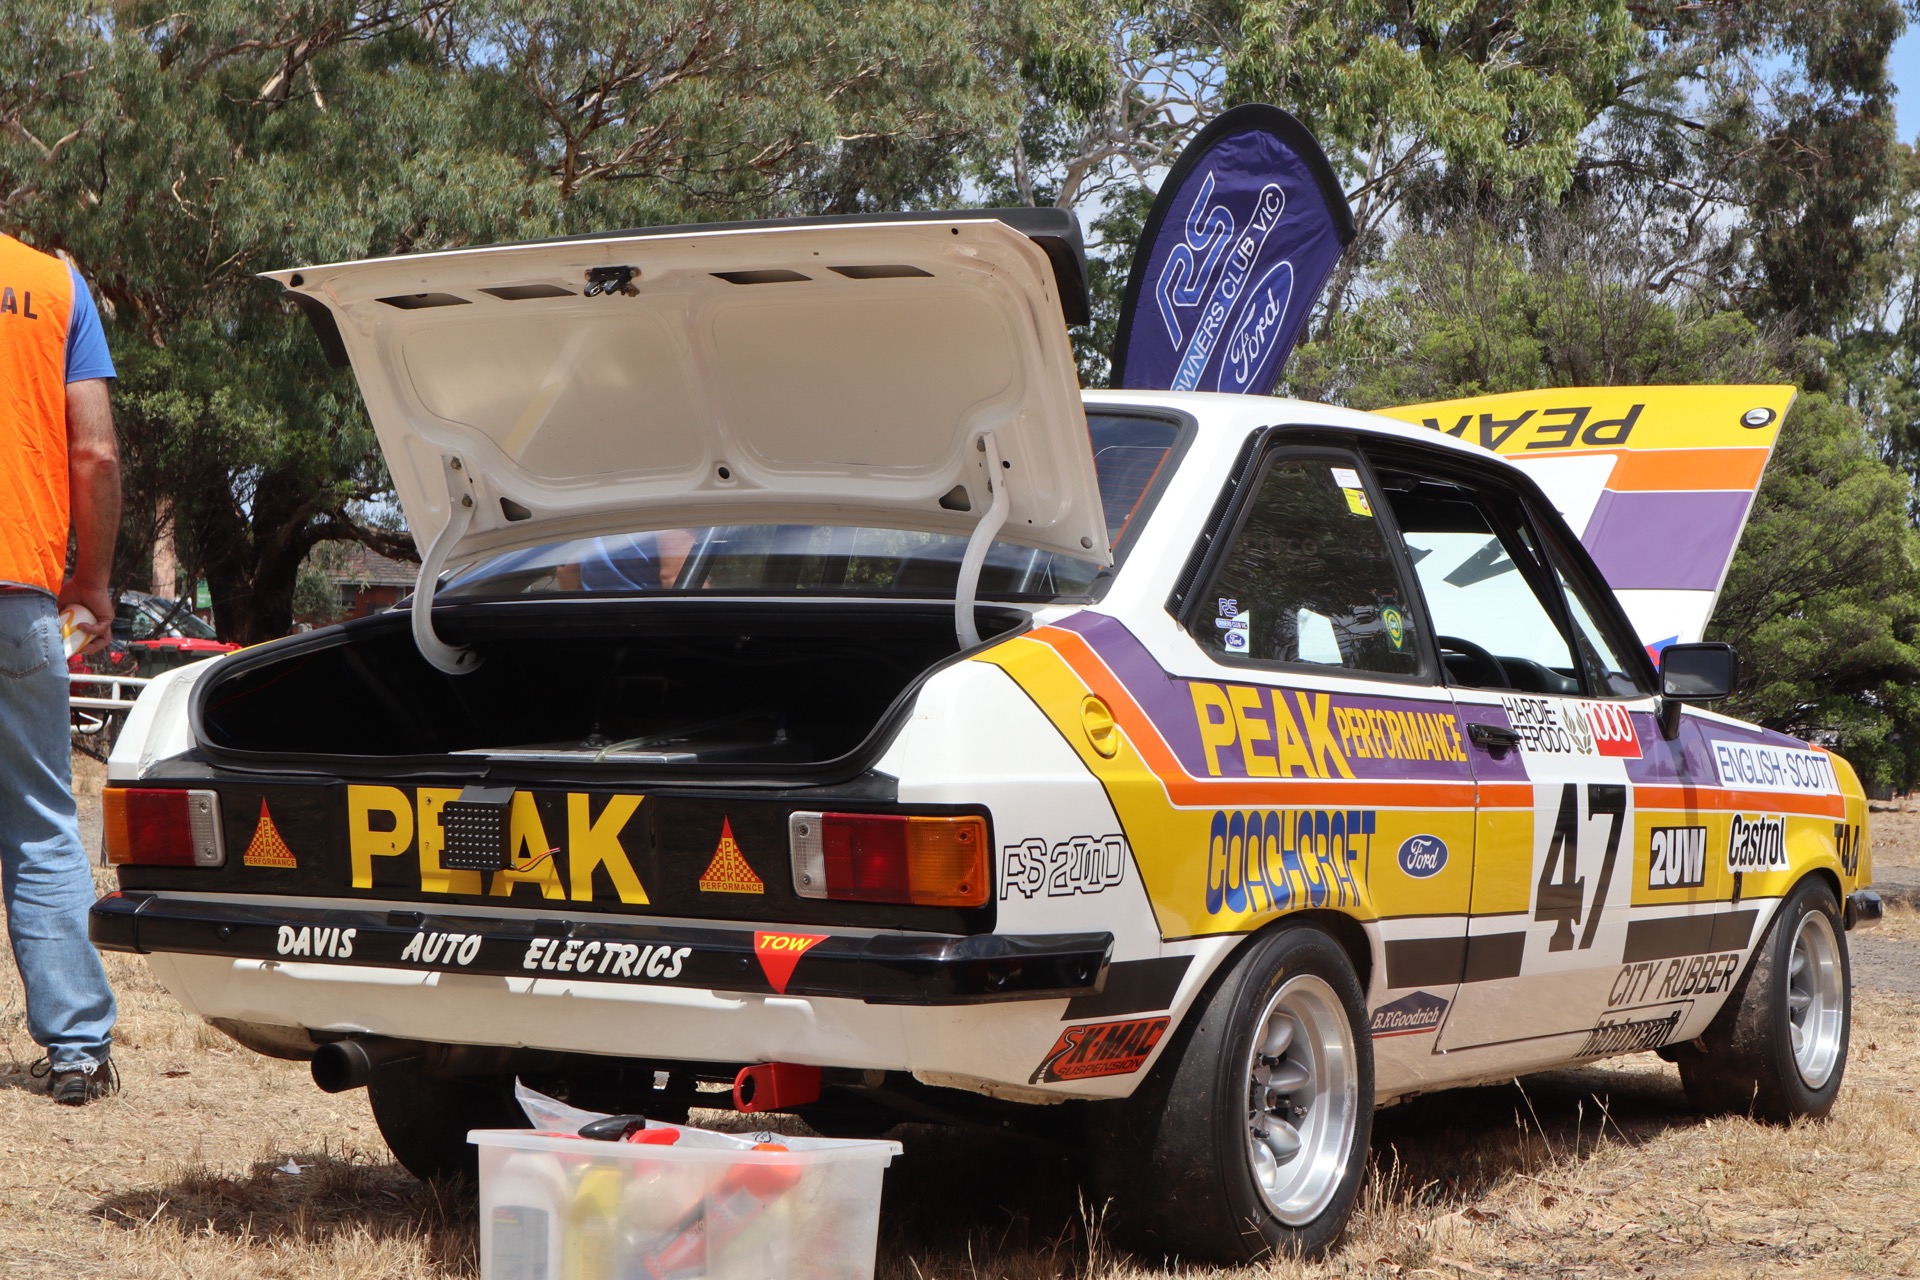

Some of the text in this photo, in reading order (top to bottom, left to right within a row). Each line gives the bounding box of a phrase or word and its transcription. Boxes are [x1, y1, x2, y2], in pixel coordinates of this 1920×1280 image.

[1156, 170, 1235, 352] RS
[1222, 236, 1255, 299] CLUB
[1253, 192, 1280, 232] VIC
[1230, 287, 1280, 384] Ford
[1218, 597, 1239, 618] RS
[1229, 633, 1242, 646] Ford
[1189, 682, 1468, 779] PEAK PERFORMANCE
[1513, 725, 1571, 753] FERODO
[1583, 702, 1633, 742] 1000
[244, 857, 296, 867] PERFORMANCE
[262, 819, 272, 857] PEAK
[724, 840, 735, 882] PEAK
[1206, 810, 1376, 915] COACHCRAFT
[1406, 838, 1438, 871] Ford
[1650, 828, 1706, 885] 2UW
[1728, 813, 1787, 867] Castrol
[1834, 823, 1860, 877] TAA
[700, 882, 763, 892] PERFORMANCE
[1000, 838, 1047, 900] RS
[1534, 783, 1627, 952] 47
[277, 925, 692, 979] DAVIS AUTO ELECTRICS
[759, 935, 813, 951] TOW
[1607, 953, 1740, 1007] CITY RUBBER
[1058, 1059, 1144, 1076] SUSPENSION
